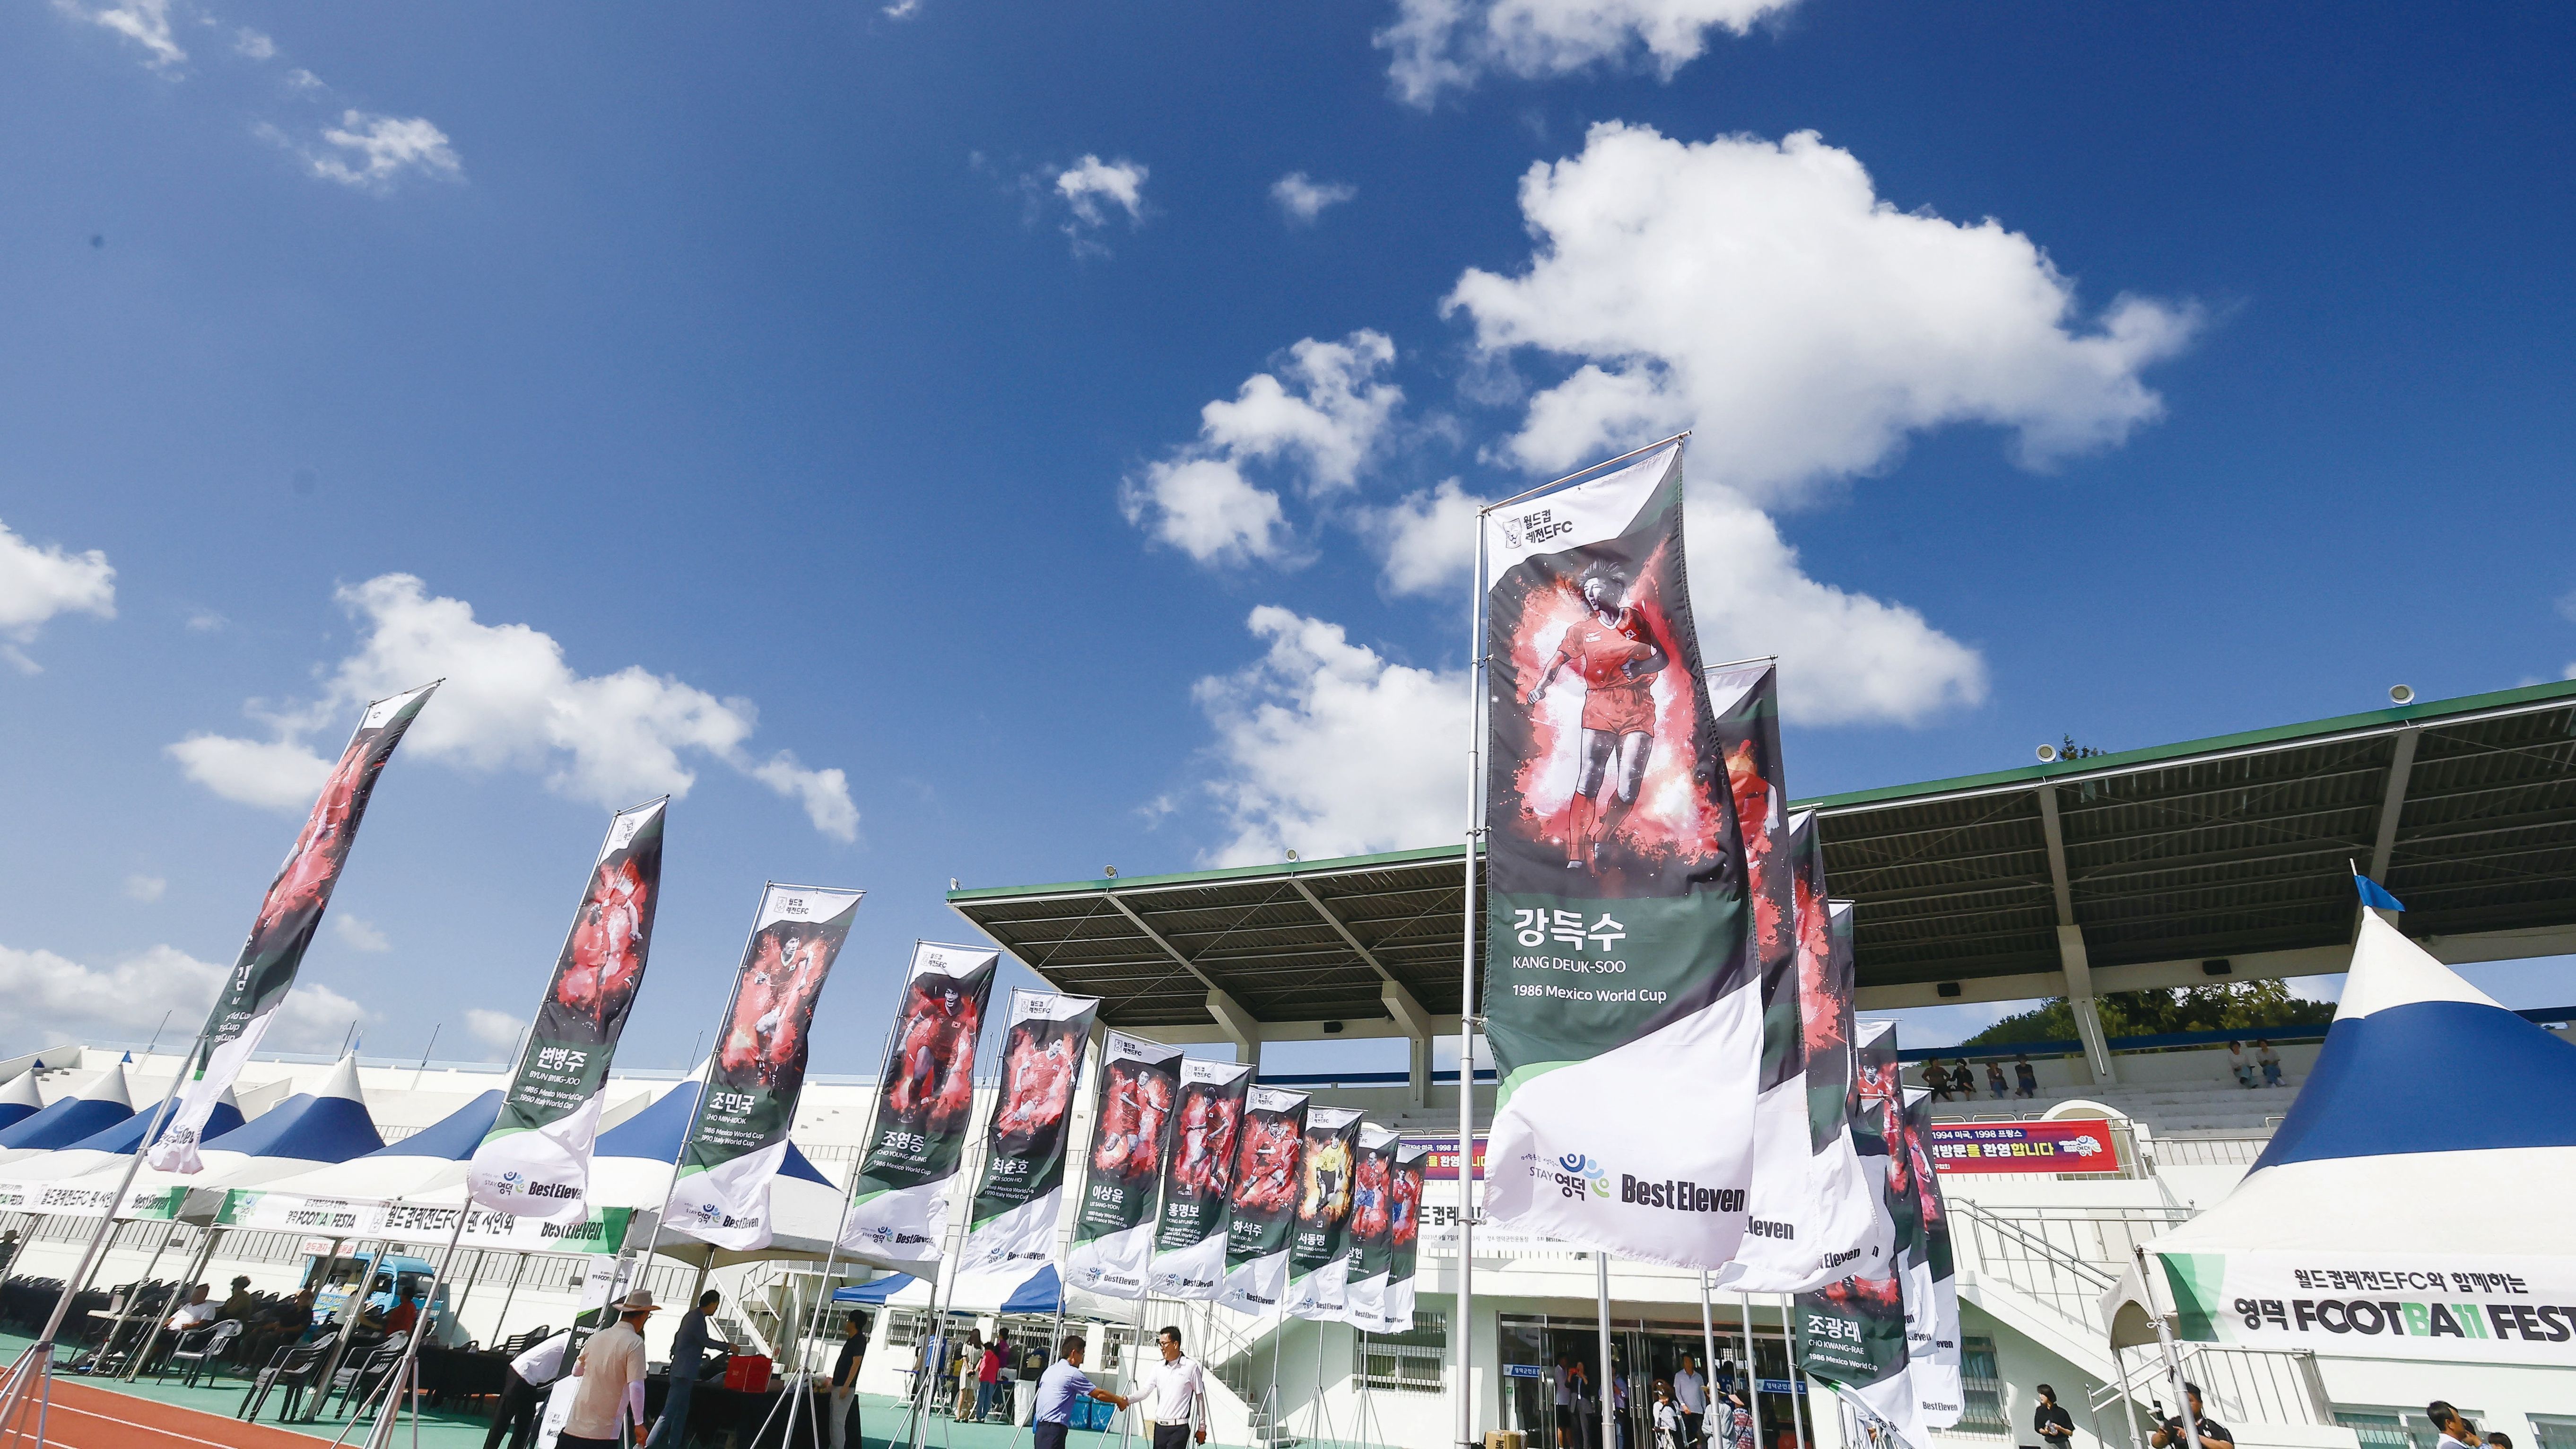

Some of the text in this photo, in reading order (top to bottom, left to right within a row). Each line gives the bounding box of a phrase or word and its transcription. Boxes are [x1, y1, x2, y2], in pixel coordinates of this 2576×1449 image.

[1523, 508, 1551, 530] 월드컵
[1525, 521, 1573, 544] 레전드FC
[1514, 908, 1626, 952] 강득수
[1513, 956, 1626, 973] KANG DEUK-SOO
[1513, 985, 1667, 1004] 1986 Mexico World Cup
[1123, 1048, 1142, 1056] 레전드FC
[537, 1047, 588, 1073] 변병주
[529, 1070, 548, 1081] BYUN
[524, 1085, 539, 1094] 1986
[556, 1091, 575, 1100] World
[520, 1093, 535, 1102] 1990
[546, 1099, 564, 1108] World
[709, 1092, 756, 1114] 조민국
[701, 1134, 714, 1142] 1990
[724, 1137, 742, 1145] World
[704, 1126, 764, 1140] 1986 Mexico World Cup
[1932, 1129, 2023, 1140] 1994 미국, 1998 프랑스
[881, 1130, 924, 1152] 조영증
[1983, 1142, 2054, 1157] 환영합니다
[2076, 1145, 2091, 1155] 영덕
[886, 1162, 905, 1170] Mexico
[905, 1166, 921, 1174] World
[921, 1168, 931, 1176] Cup
[992, 1157, 1028, 1174] 최순호
[497, 1182, 513, 1196] 영덕
[1530, 1167, 1585, 1202] STAY 영덕
[1092, 1185, 1123, 1204] 이상윤
[697, 1211, 711, 1224] 영덕
[1168, 1203, 1200, 1218] 홍명보
[331, 1213, 356, 1228] FESTA
[467, 1211, 480, 1233] 팬
[1233, 1220, 1262, 1237] 하석주
[305, 1242, 328, 1251] 호두과자
[872, 1234, 886, 1244] 영덕
[1298, 1233, 1325, 1246] 서동명
[2294, 1269, 2529, 1294] 월드컵레전드FC와 함께하는
[2234, 1298, 2289, 1331] 영덕
[1808, 1314, 1862, 1343] 조광래
[1808, 1339, 1864, 1355] CHO KWANG-RAE
[1809, 1353, 1825, 1361] 1986
[1826, 1355, 1848, 1366] Mexico
[1849, 1359, 1869, 1370] World
[1923, 1401, 1958, 1411] BestEleven
